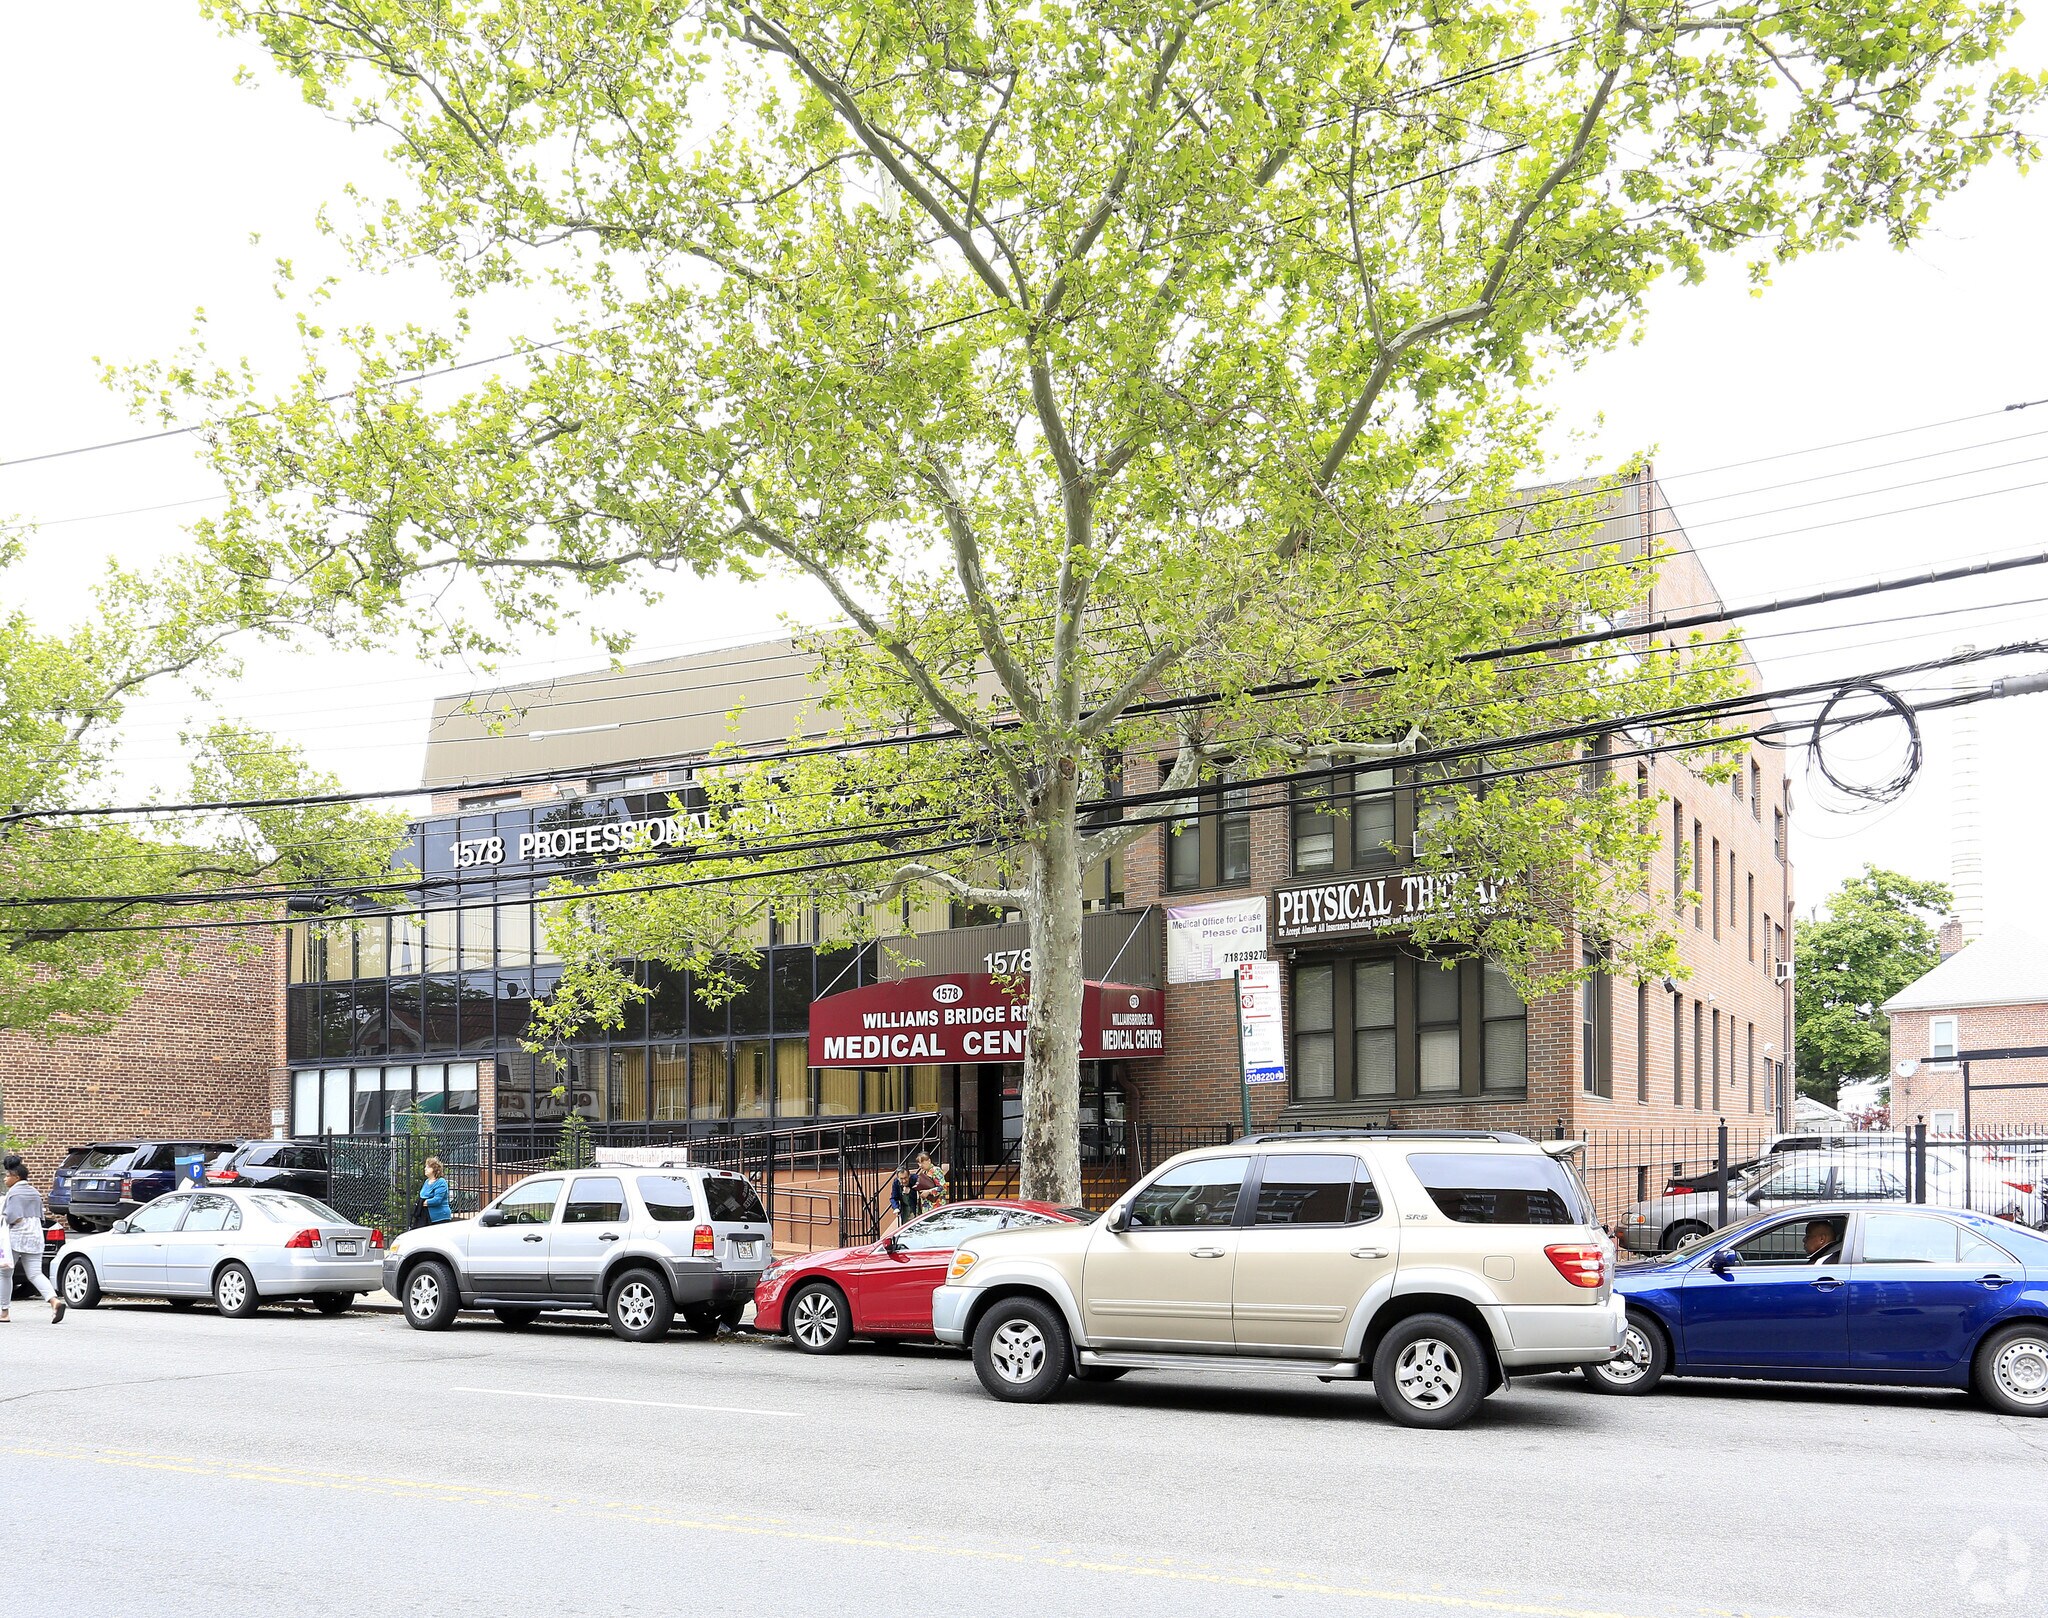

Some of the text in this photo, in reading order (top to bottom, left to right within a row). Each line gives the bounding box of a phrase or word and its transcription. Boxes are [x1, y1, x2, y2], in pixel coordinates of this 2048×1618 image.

[449, 836, 503, 868] 1578
[1278, 879, 1393, 926] PHYSICAL
[1172, 912, 1261, 930] Medical Office for Lease
[1202, 924, 1262, 938] Please Call
[1351, 916, 1371, 930] Including
[983, 948, 1032, 974] 1578
[936, 986, 959, 1001] 1578
[862, 1009, 939, 1029] WILLIAMS
[944, 1006, 1005, 1025] BRIDGE
[823, 1032, 946, 1060] MEDICAL
[1102, 1029, 1163, 1051] MEDICAL CENTER
[1246, 1072, 1275, 1082] 208220
